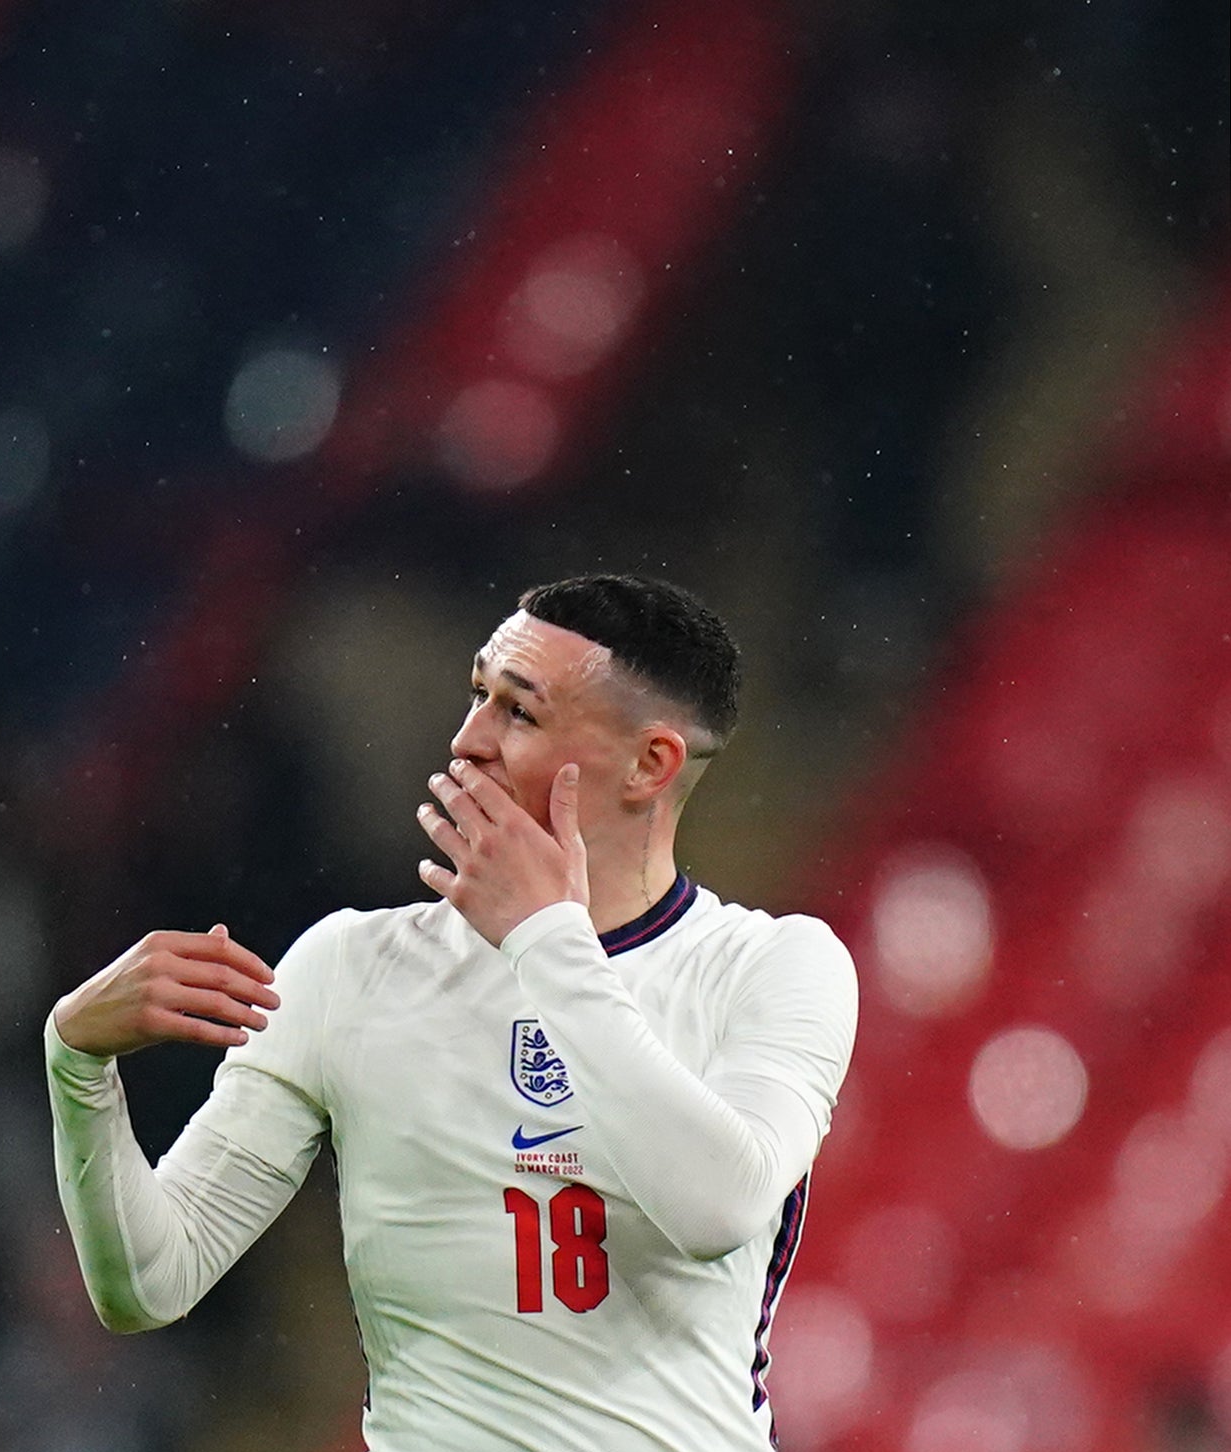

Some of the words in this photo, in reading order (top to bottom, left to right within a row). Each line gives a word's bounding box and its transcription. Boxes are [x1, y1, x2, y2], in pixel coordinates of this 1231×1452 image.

[516, 1152, 545, 1163] IVORY
[548, 1152, 579, 1163] COAST
[527, 1164, 560, 1175] MARCH
[562, 1164, 584, 1176] 2022
[503, 1182, 610, 1313] 18
